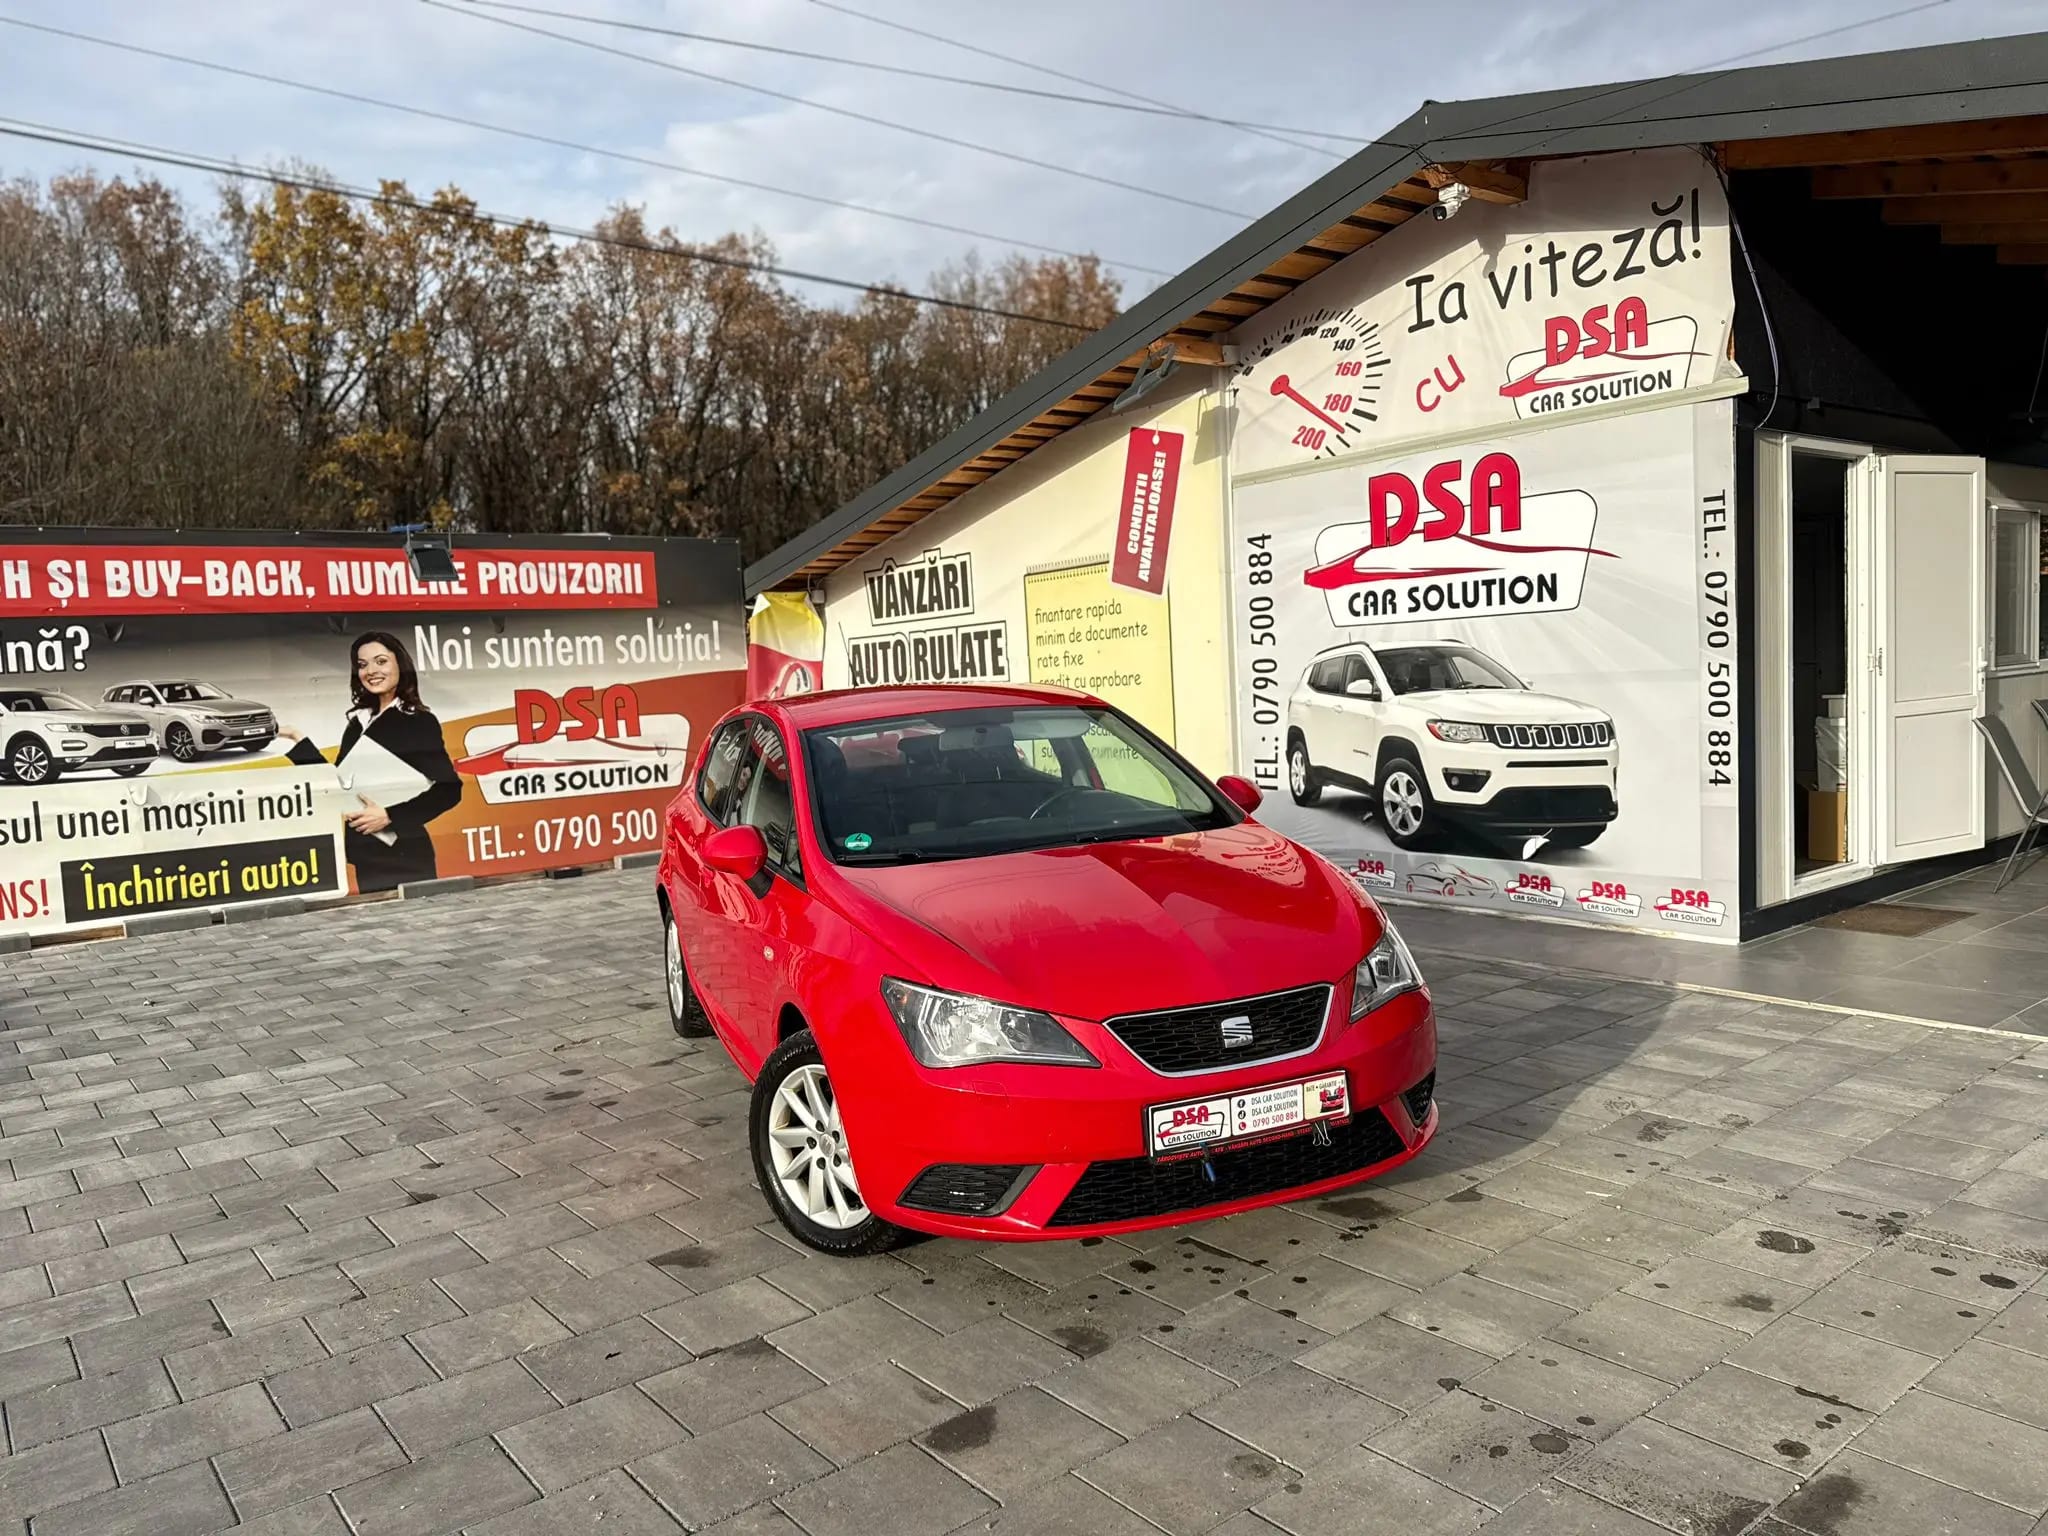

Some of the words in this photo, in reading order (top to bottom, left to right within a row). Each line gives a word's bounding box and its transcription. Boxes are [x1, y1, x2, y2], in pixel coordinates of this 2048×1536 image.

[1405, 274, 1468, 333] Ia
[1488, 188, 1702, 309] viteză!
[1320, 327, 1339, 338] 120
[1333, 338, 1355, 351] 140
[1544, 296, 1649, 366] DSA
[1335, 361, 1362, 376] 160
[1416, 354, 1465, 412] cu
[1323, 393, 1352, 413] 180
[1530, 390, 1565, 413] CAR
[1572, 370, 1672, 406] SOLUTION
[1292, 426, 1326, 450] 200
[1368, 452, 1521, 548] DSA
[1702, 489, 1727, 559] TEL.:
[1247, 533, 1273, 585] 884
[0, 560, 32, 599] H
[104, 559, 315, 599] BUY-BACK,
[478, 561, 644, 595] PROVIZORII
[868, 556, 970, 619] VÂNZĂRI
[1348, 588, 1398, 617] CAR
[1408, 572, 1557, 613] SOLUTION
[1035, 606, 1083, 624] finantare
[1086, 598, 1122, 621] rapida
[1249, 596, 1276, 646] 500
[1704, 571, 1730, 648] 0790
[0, 625, 90, 673] nă?
[414, 625, 473, 671] Noi
[485, 628, 604, 669] suntem
[616, 617, 721, 669] soluția!
[1036, 629, 1065, 647] minim
[1069, 626, 1082, 643] de
[1086, 622, 1148, 641] documente
[852, 638, 908, 686] AUTO
[913, 629, 1005, 681] RULATE
[1037, 653, 1060, 668] rate
[1063, 650, 1084, 667] fixe
[1074, 676, 1086, 688] cu
[1089, 670, 1142, 693] aprobare
[1252, 658, 1279, 725] 0790
[1707, 662, 1731, 717] 500
[513, 683, 642, 745] DSA
[1708, 730, 1732, 786] 884
[500, 772, 546, 797] CAR
[554, 764, 669, 792] SOLUTION
[57, 799, 130, 840] unei
[143, 791, 246, 835] mașini
[258, 782, 314, 821] noi!
[462, 826, 526, 862] TEL.:
[534, 818, 601, 853] 0790
[611, 808, 658, 845] 500
[80, 859, 230, 911] Închirieri
[241, 849, 320, 891] auto!
[1358, 858, 1385, 874] DSA
[1519, 873, 1551, 892] DSA
[1513, 894, 1525, 902] CAR
[1527, 896, 1558, 906] SOLUTION
[1592, 881, 1626, 900] DSA
[1671, 888, 1709, 908] DSA
[1586, 903, 1599, 911] CAR
[1601, 905, 1634, 915] SOLUTION
[1665, 912, 1679, 920] CAR
[1681, 913, 1717, 924] SOLUTION
[1252, 1108, 1262, 1116] DSA
[1263, 1105, 1273, 1114] CAR
[1274, 1100, 1298, 1112] SOLUTION
[1263, 1094, 1272, 1103] CAR
[1273, 1089, 1298, 1101] SOLUTION
[1173, 1105, 1209, 1127] DSA
[1253, 1117, 1270, 1127] 0790
[1272, 1114, 1284, 1124] 500
[1167, 1135, 1181, 1143] CAR
[1183, 1129, 1217, 1141] SOLUTION
